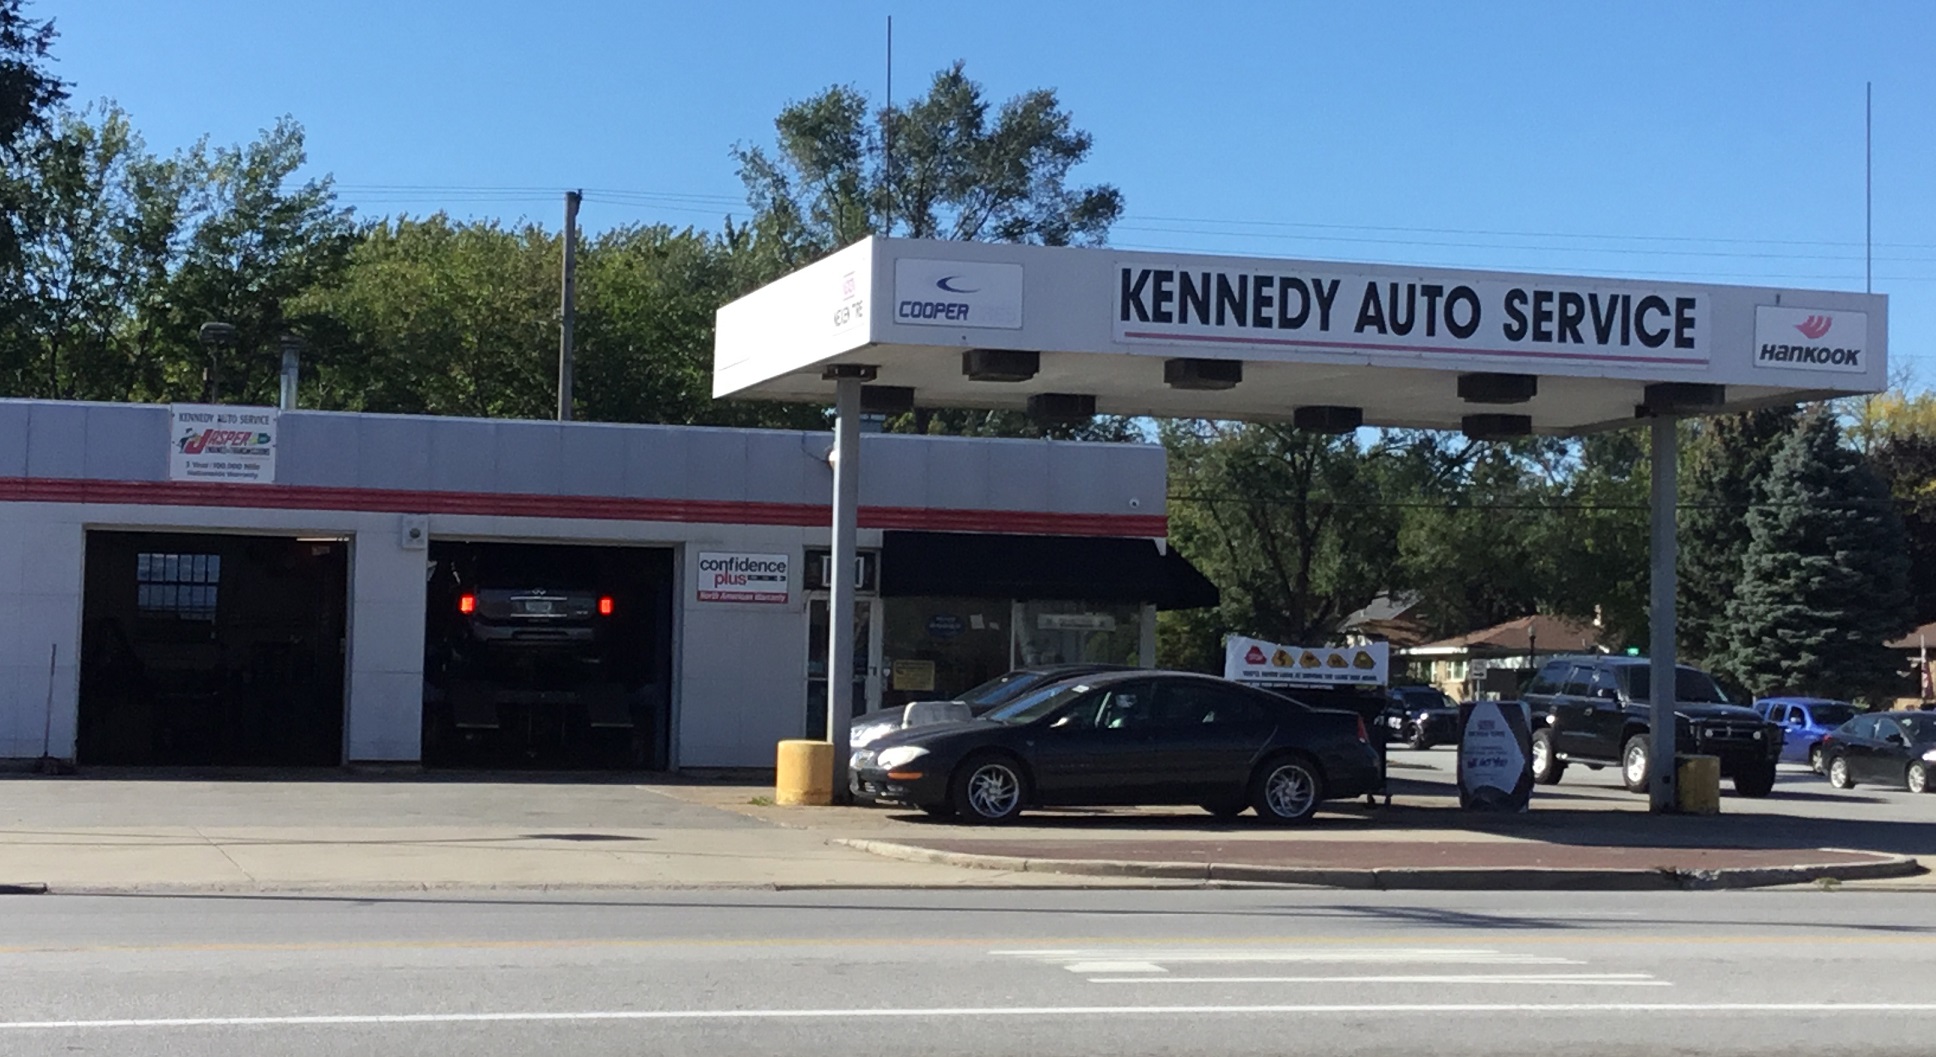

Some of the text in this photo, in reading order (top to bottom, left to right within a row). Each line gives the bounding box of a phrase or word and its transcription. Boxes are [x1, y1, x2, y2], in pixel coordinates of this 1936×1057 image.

[899, 300, 970, 321] COOPER
[1120, 267, 1697, 349] KENNEDY AUTO SERVICE
[179, 412, 270, 425] KENNEDY AUTO SERVICE
[183, 428, 252, 455] JASPER
[700, 557, 787, 573] confidence
[714, 572, 747, 588] plus
